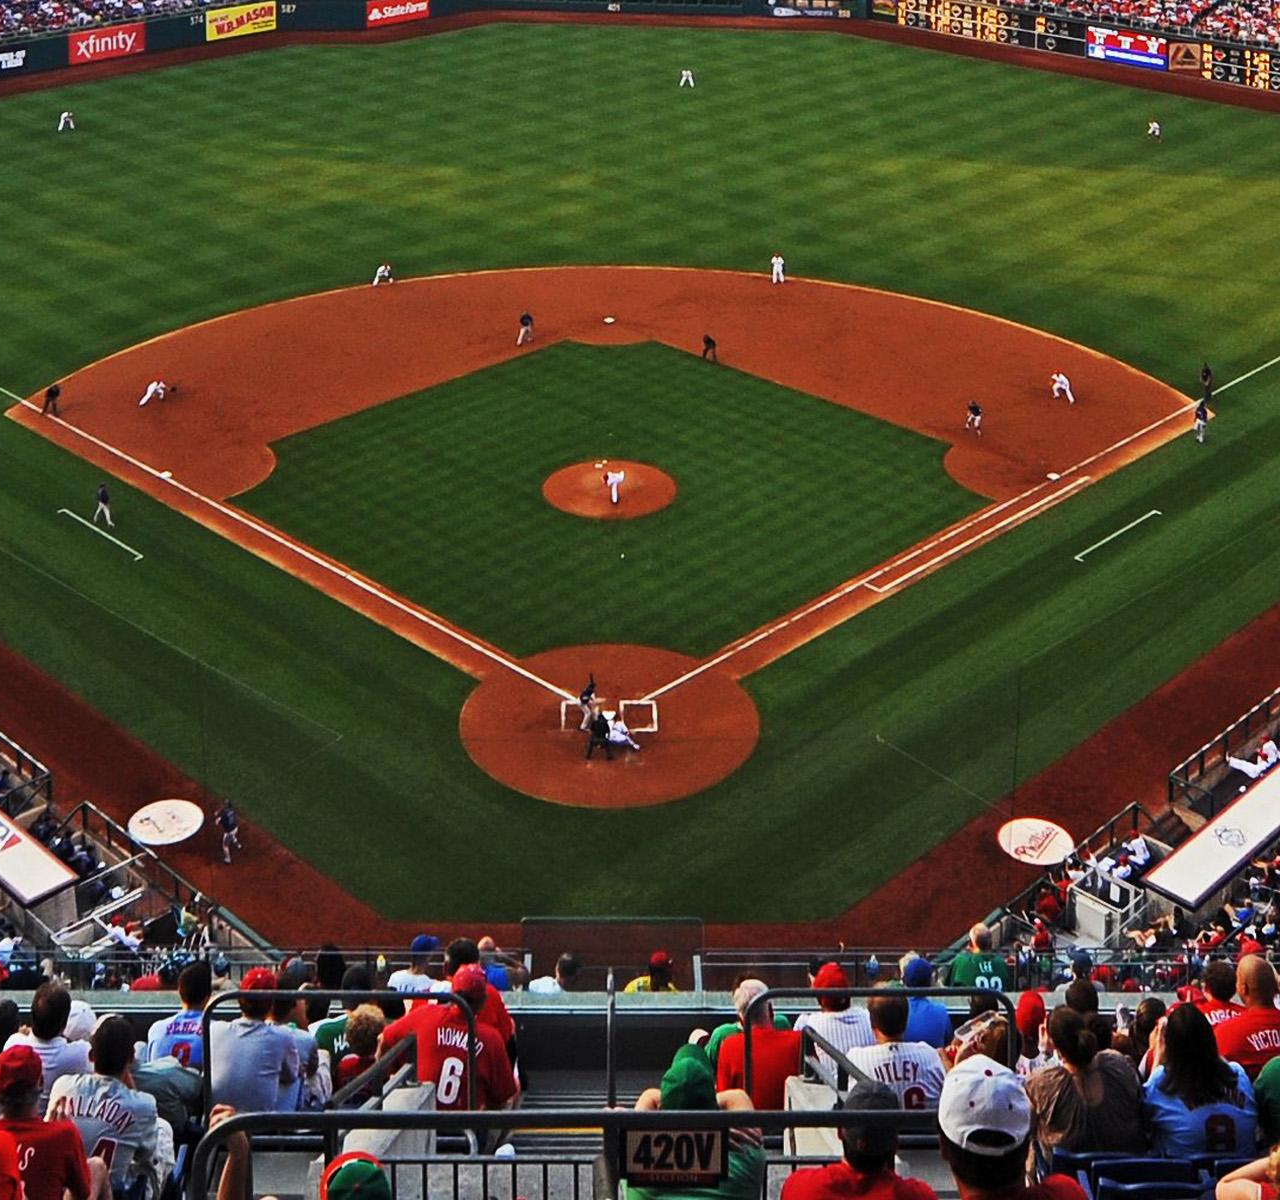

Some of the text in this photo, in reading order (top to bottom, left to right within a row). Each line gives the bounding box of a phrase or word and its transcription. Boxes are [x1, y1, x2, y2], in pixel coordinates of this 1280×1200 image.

[77, 31, 137, 58] xfinity
[437, 1027, 483, 1056] HOWAD
[436, 1057, 465, 1105] 6
[874, 1061, 919, 1084] UTLEY
[632, 1133, 715, 1171] 420V
